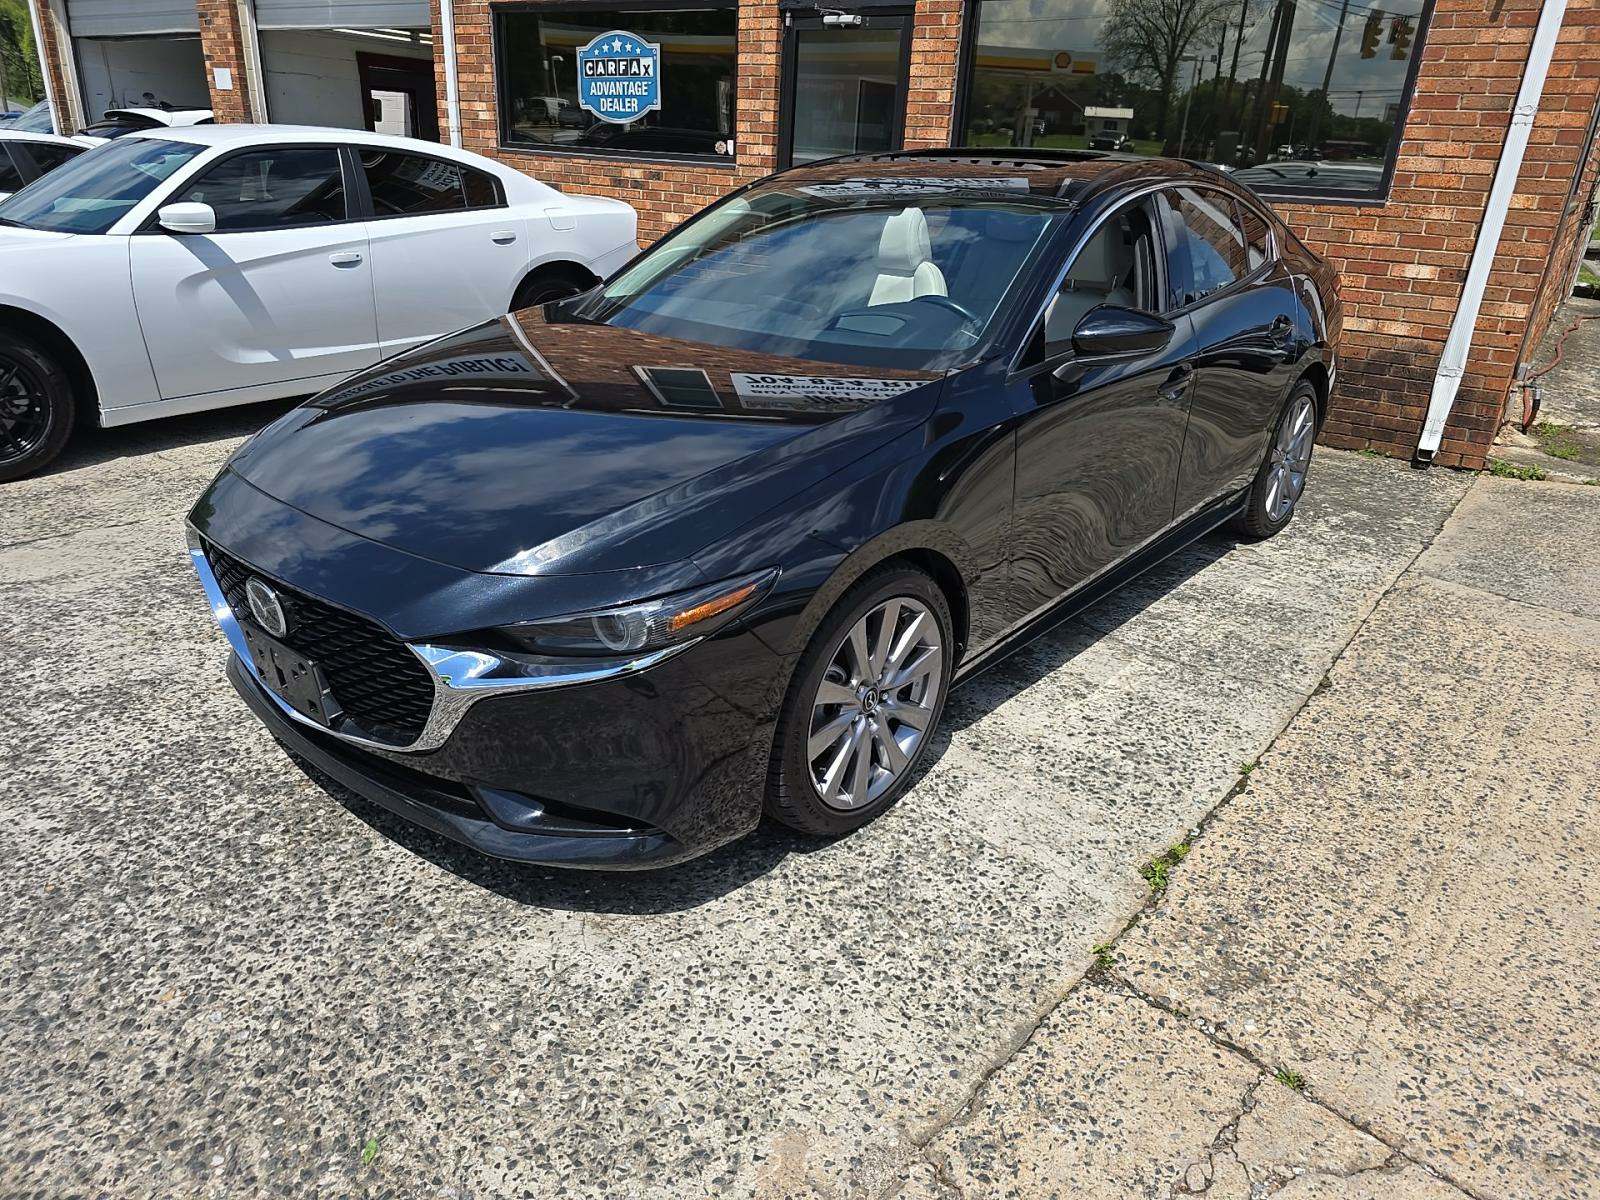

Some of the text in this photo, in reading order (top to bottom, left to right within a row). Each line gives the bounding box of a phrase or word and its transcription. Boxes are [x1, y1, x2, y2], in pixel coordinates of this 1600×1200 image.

[585, 60, 651, 76] CARFAX
[590, 81, 648, 96] ADVANTAGE
[600, 98, 638, 112] DEALER
